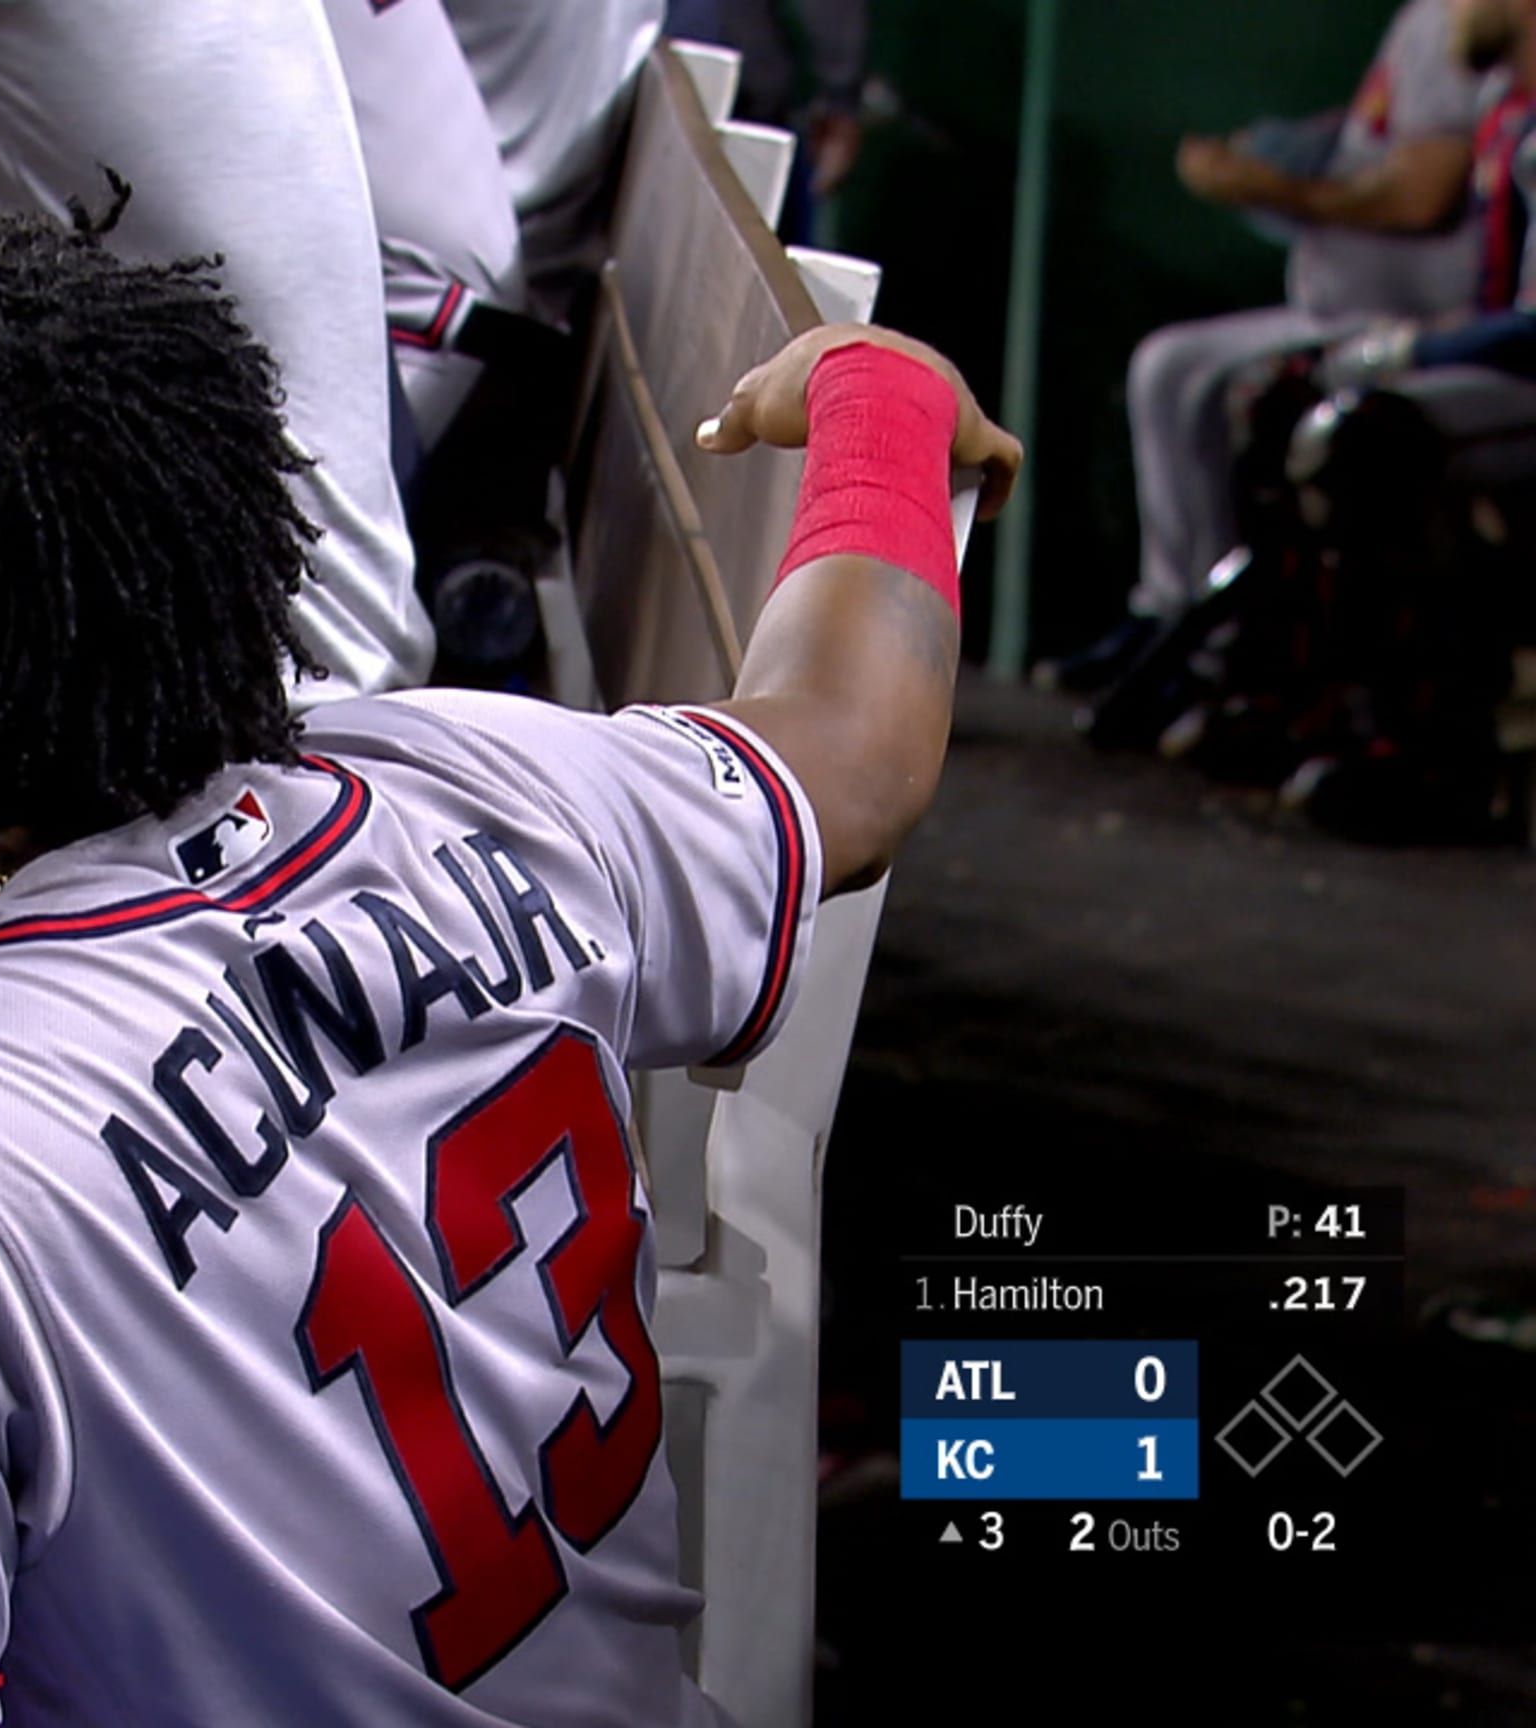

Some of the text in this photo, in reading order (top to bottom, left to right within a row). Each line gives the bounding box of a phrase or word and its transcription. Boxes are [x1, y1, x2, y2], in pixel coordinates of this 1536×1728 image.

[100, 831, 606, 1292] ACUÑA JR.
[293, 1021, 664, 1694] 13
